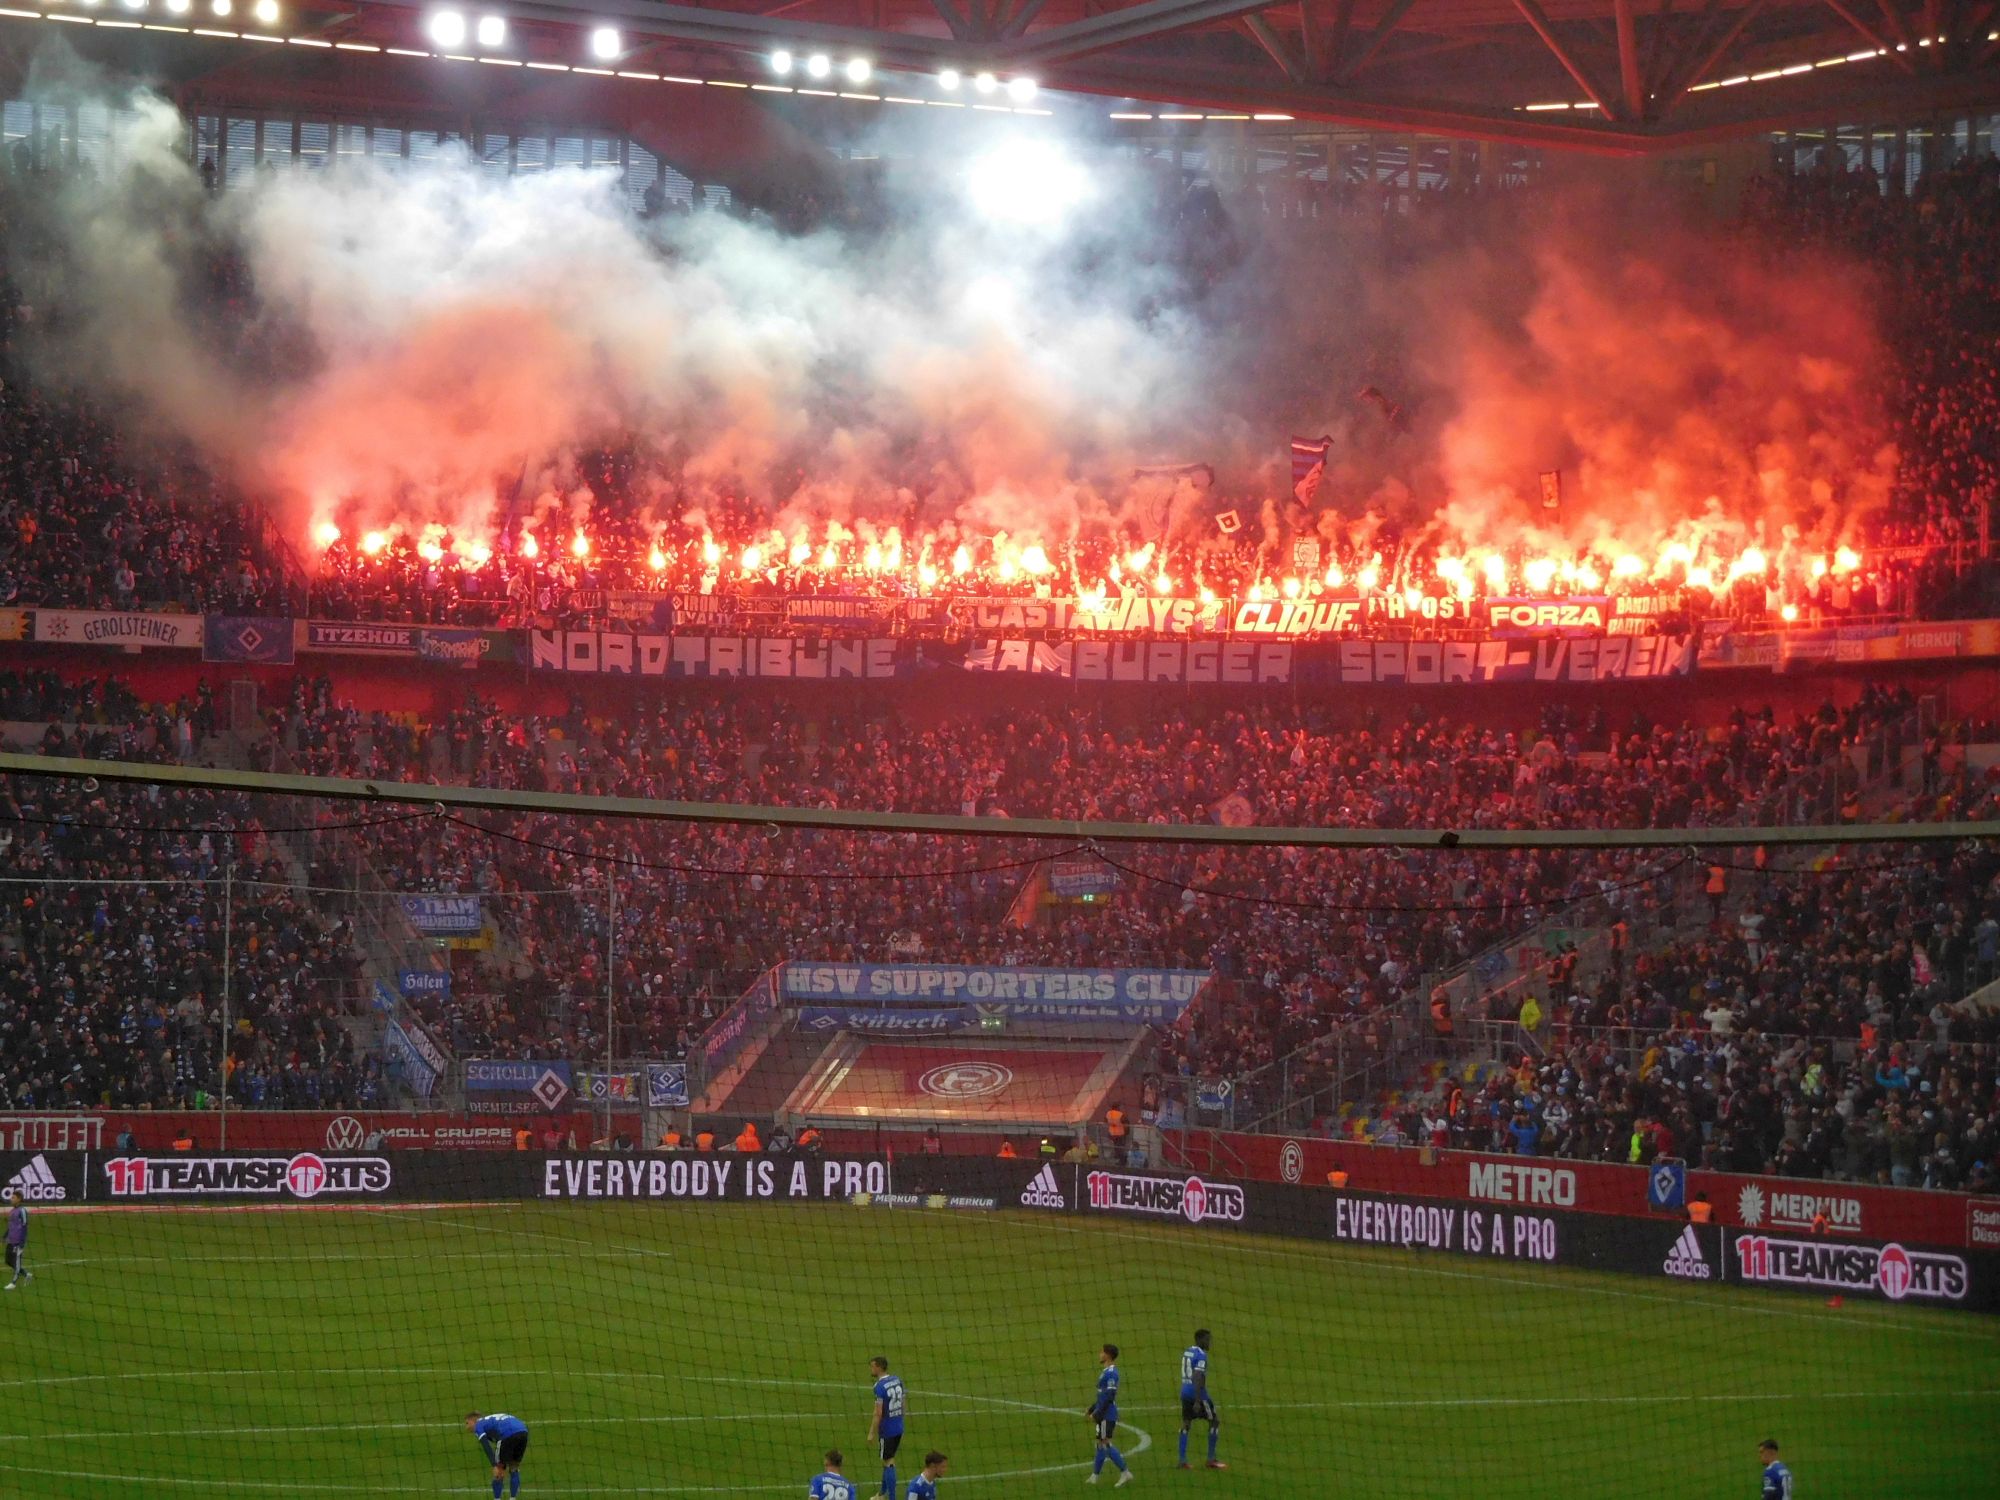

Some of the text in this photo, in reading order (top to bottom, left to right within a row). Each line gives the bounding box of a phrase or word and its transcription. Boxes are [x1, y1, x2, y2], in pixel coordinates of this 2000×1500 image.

[1234, 602, 1360, 633] CLIQUE
[1490, 605, 1600, 628] FORZA
[83, 616, 179, 643] GEROLSTEINER
[316, 627, 410, 645] ITZEHOE
[1905, 631, 1962, 649] MERKUR
[964, 639, 1292, 683] HAMBURGER
[1341, 635, 1692, 684] SPORT-VEREIN
[423, 898, 474, 914] TEAM
[409, 914, 476, 928] ORDHEIDE
[786, 967, 861, 995] HSV
[870, 969, 1117, 1001] SUPPORTERS
[467, 1065, 538, 1080] SCHOLLI
[381, 1127, 512, 1139] MOLL GRUPPE
[545, 1159, 884, 1198] EVERYBODY IS A PRO
[1469, 1161, 1576, 1206] METRO
[1, 1183, 66, 1200] adidas
[875, 1193, 918, 1204] MERKUR
[1021, 1191, 1064, 1209] adidas
[950, 1197, 993, 1207] MERKUR
[1336, 1197, 1556, 1260] EVERYBODY IS A PRO
[1972, 1226, 2000, 1243] Düss
[1663, 1256, 1710, 1279] adidas
